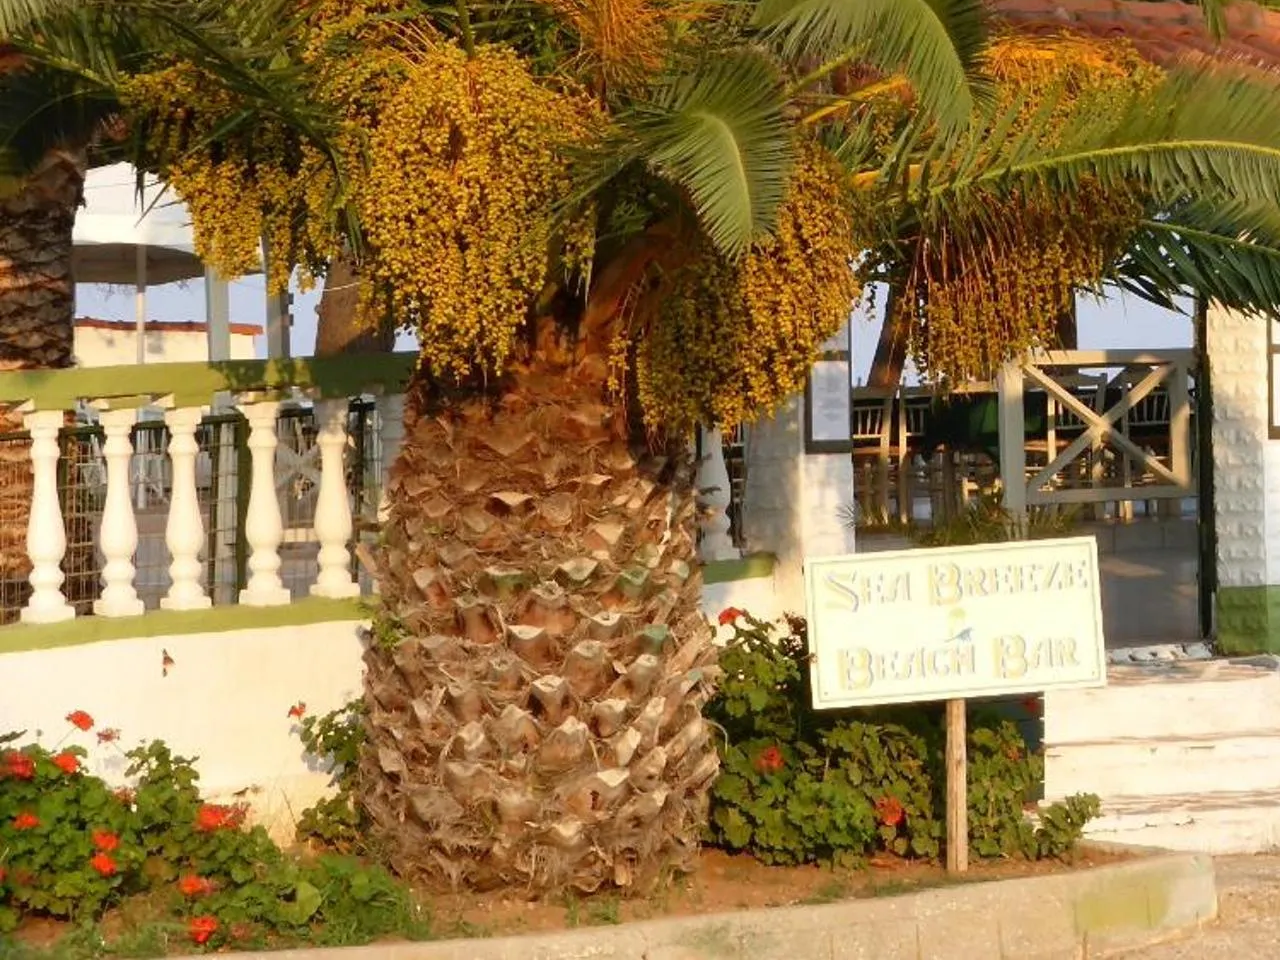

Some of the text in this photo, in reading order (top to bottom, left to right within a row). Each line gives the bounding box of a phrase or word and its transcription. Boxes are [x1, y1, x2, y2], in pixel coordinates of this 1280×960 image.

[824, 559, 1090, 612] SEA BREEZE
[836, 633, 1081, 690] BEACH BAR
